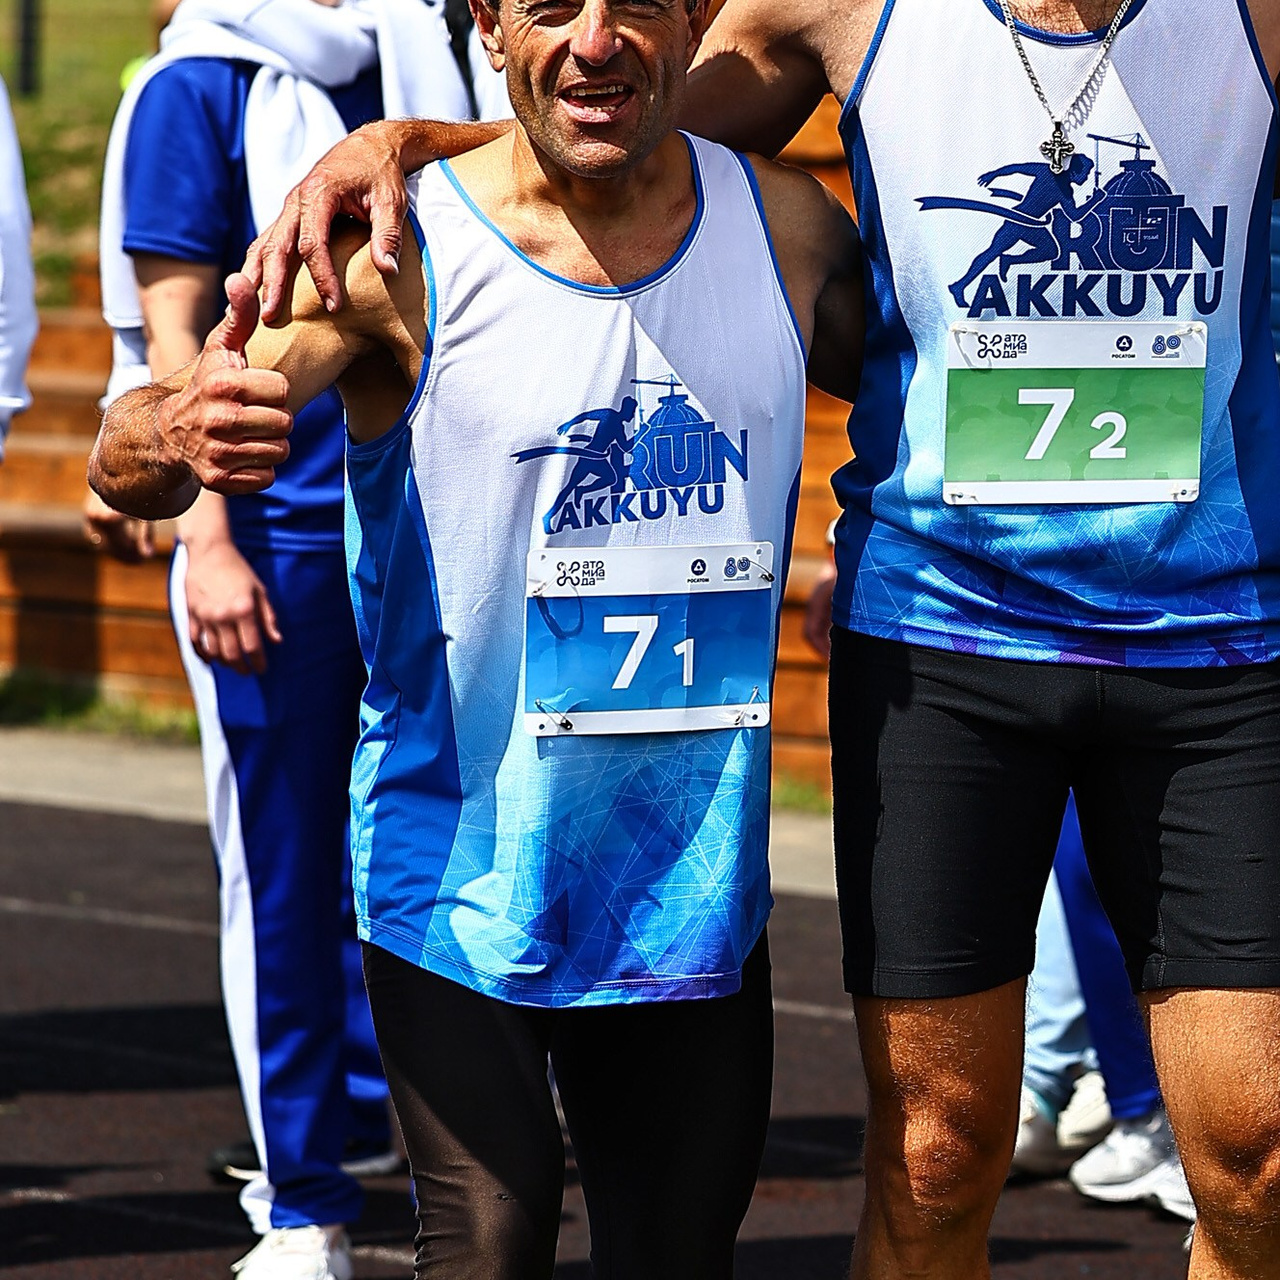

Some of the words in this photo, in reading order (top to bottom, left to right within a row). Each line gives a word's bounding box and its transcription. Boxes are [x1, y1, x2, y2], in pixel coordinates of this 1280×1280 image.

[1051, 205, 1229, 271] RUN
[967, 270, 1224, 319] AKKUYU
[1017, 387, 1075, 460] 7
[1089, 411, 1128, 459] 2
[610, 429, 749, 493] RUN
[555, 484, 726, 533] AKKUYU
[603, 615, 659, 690] 7
[673, 638, 695, 687] 1
